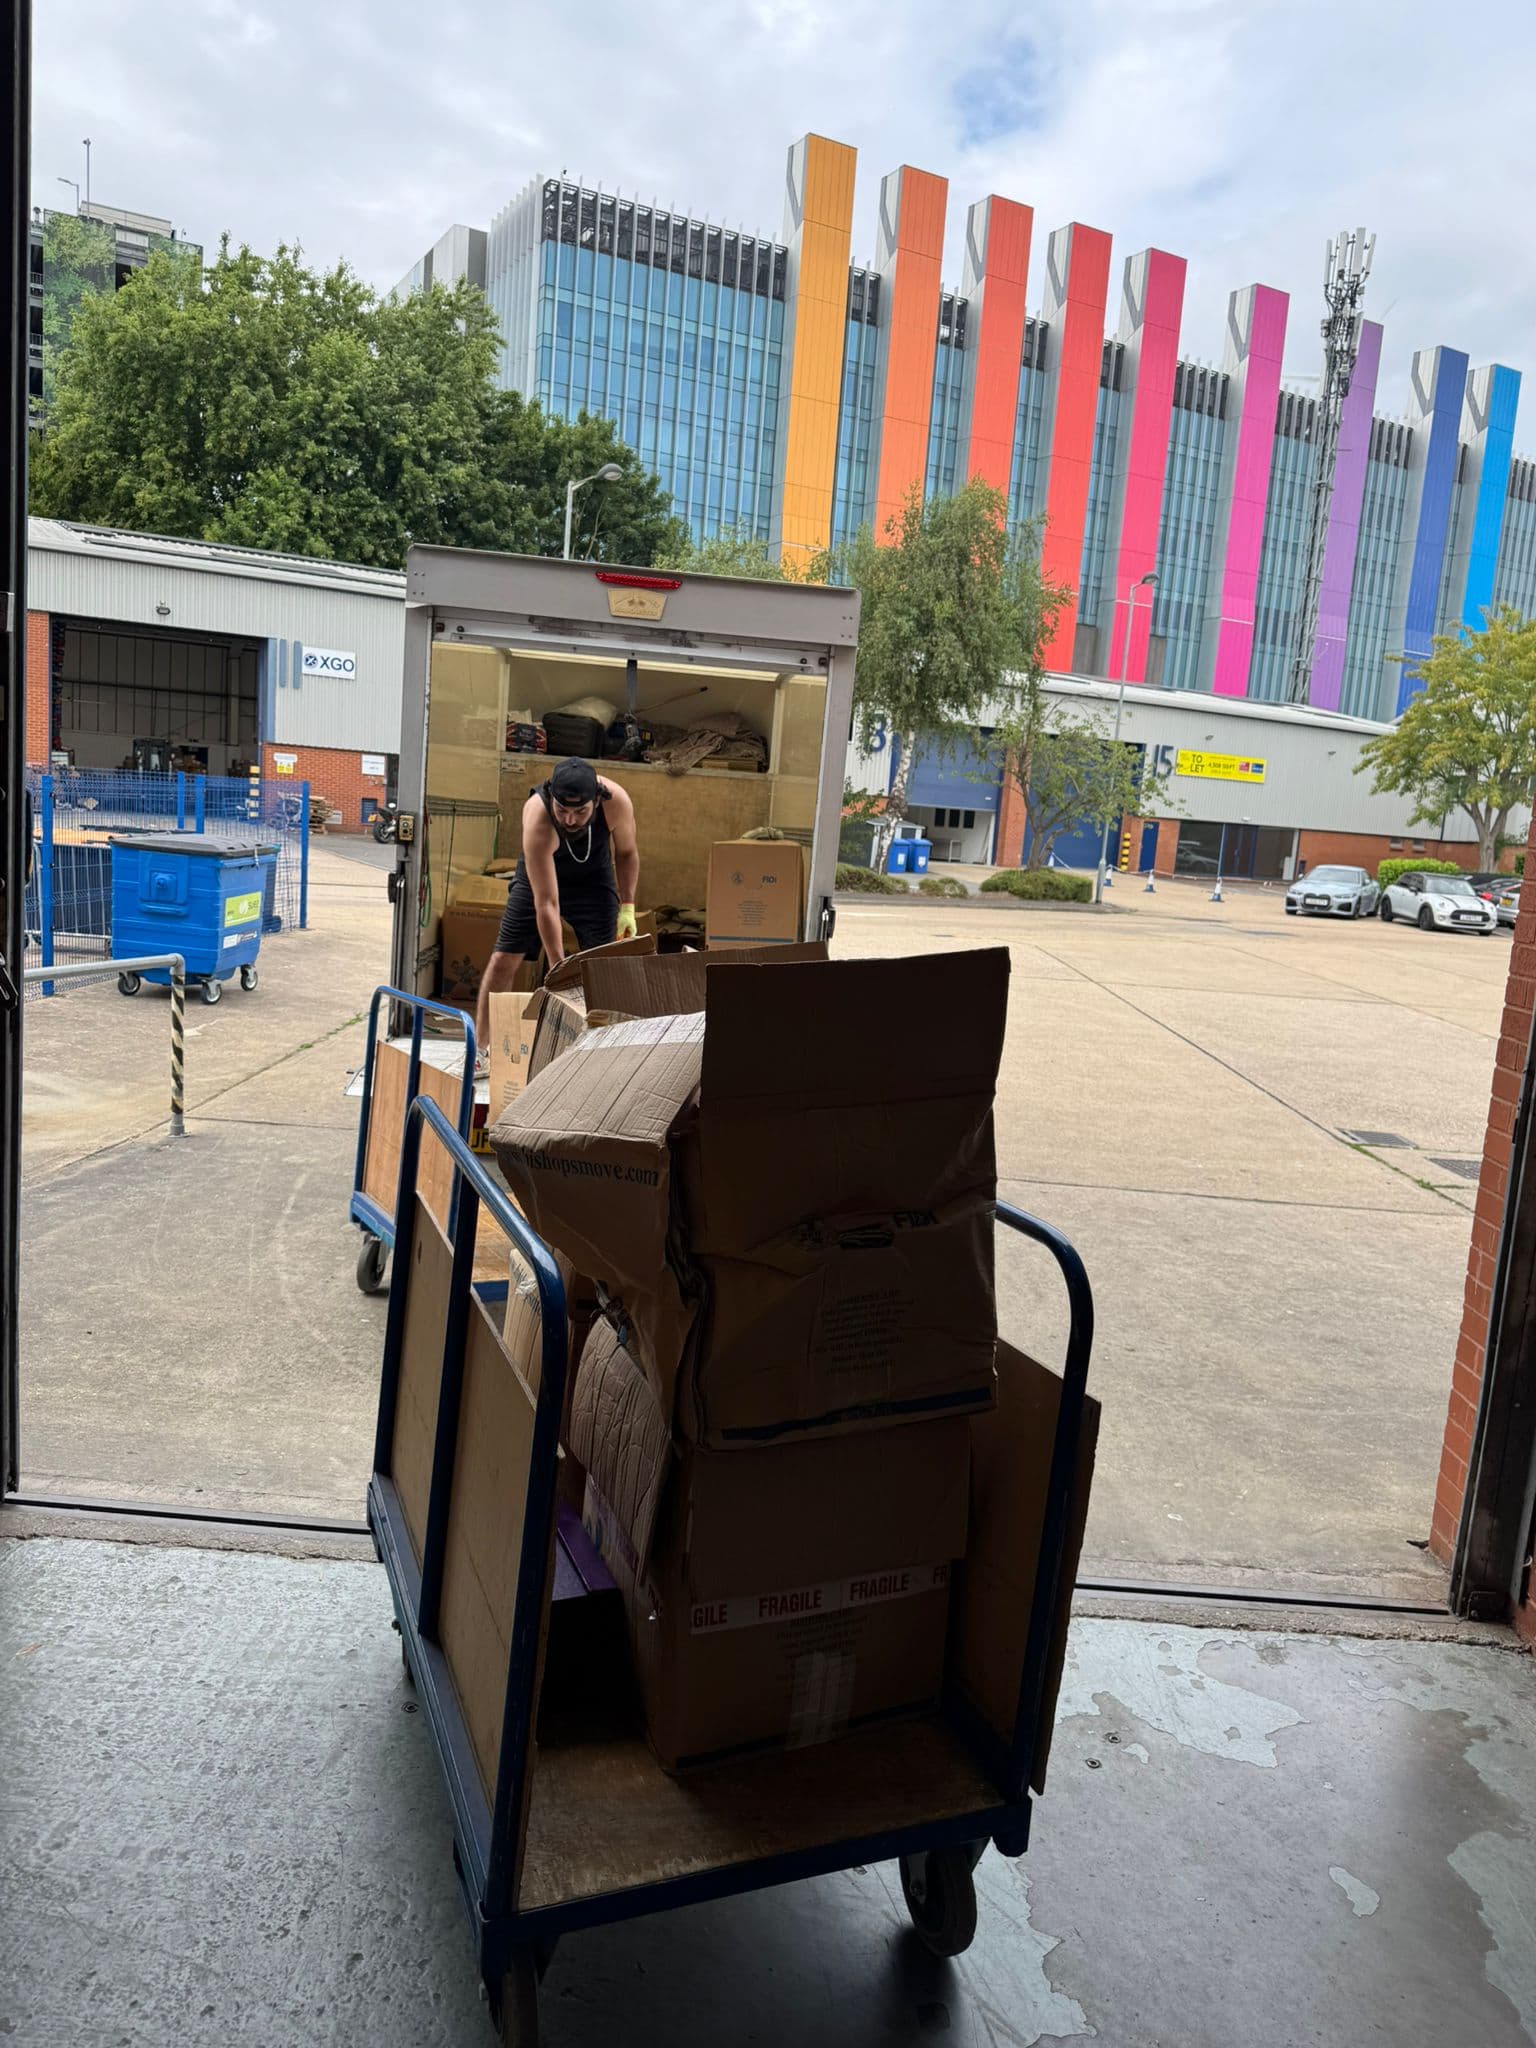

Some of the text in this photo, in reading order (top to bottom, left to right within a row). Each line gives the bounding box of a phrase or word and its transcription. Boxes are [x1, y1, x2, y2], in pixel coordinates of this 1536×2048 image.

[320, 656, 355, 672] XGO
[1152, 744, 1174, 778] 15
[1191, 754, 1203, 764] TO
[1190, 763, 1205, 773] LET
[759, 1589, 823, 1618] FRAGILE
[849, 1573, 910, 1601] FRAGILE
